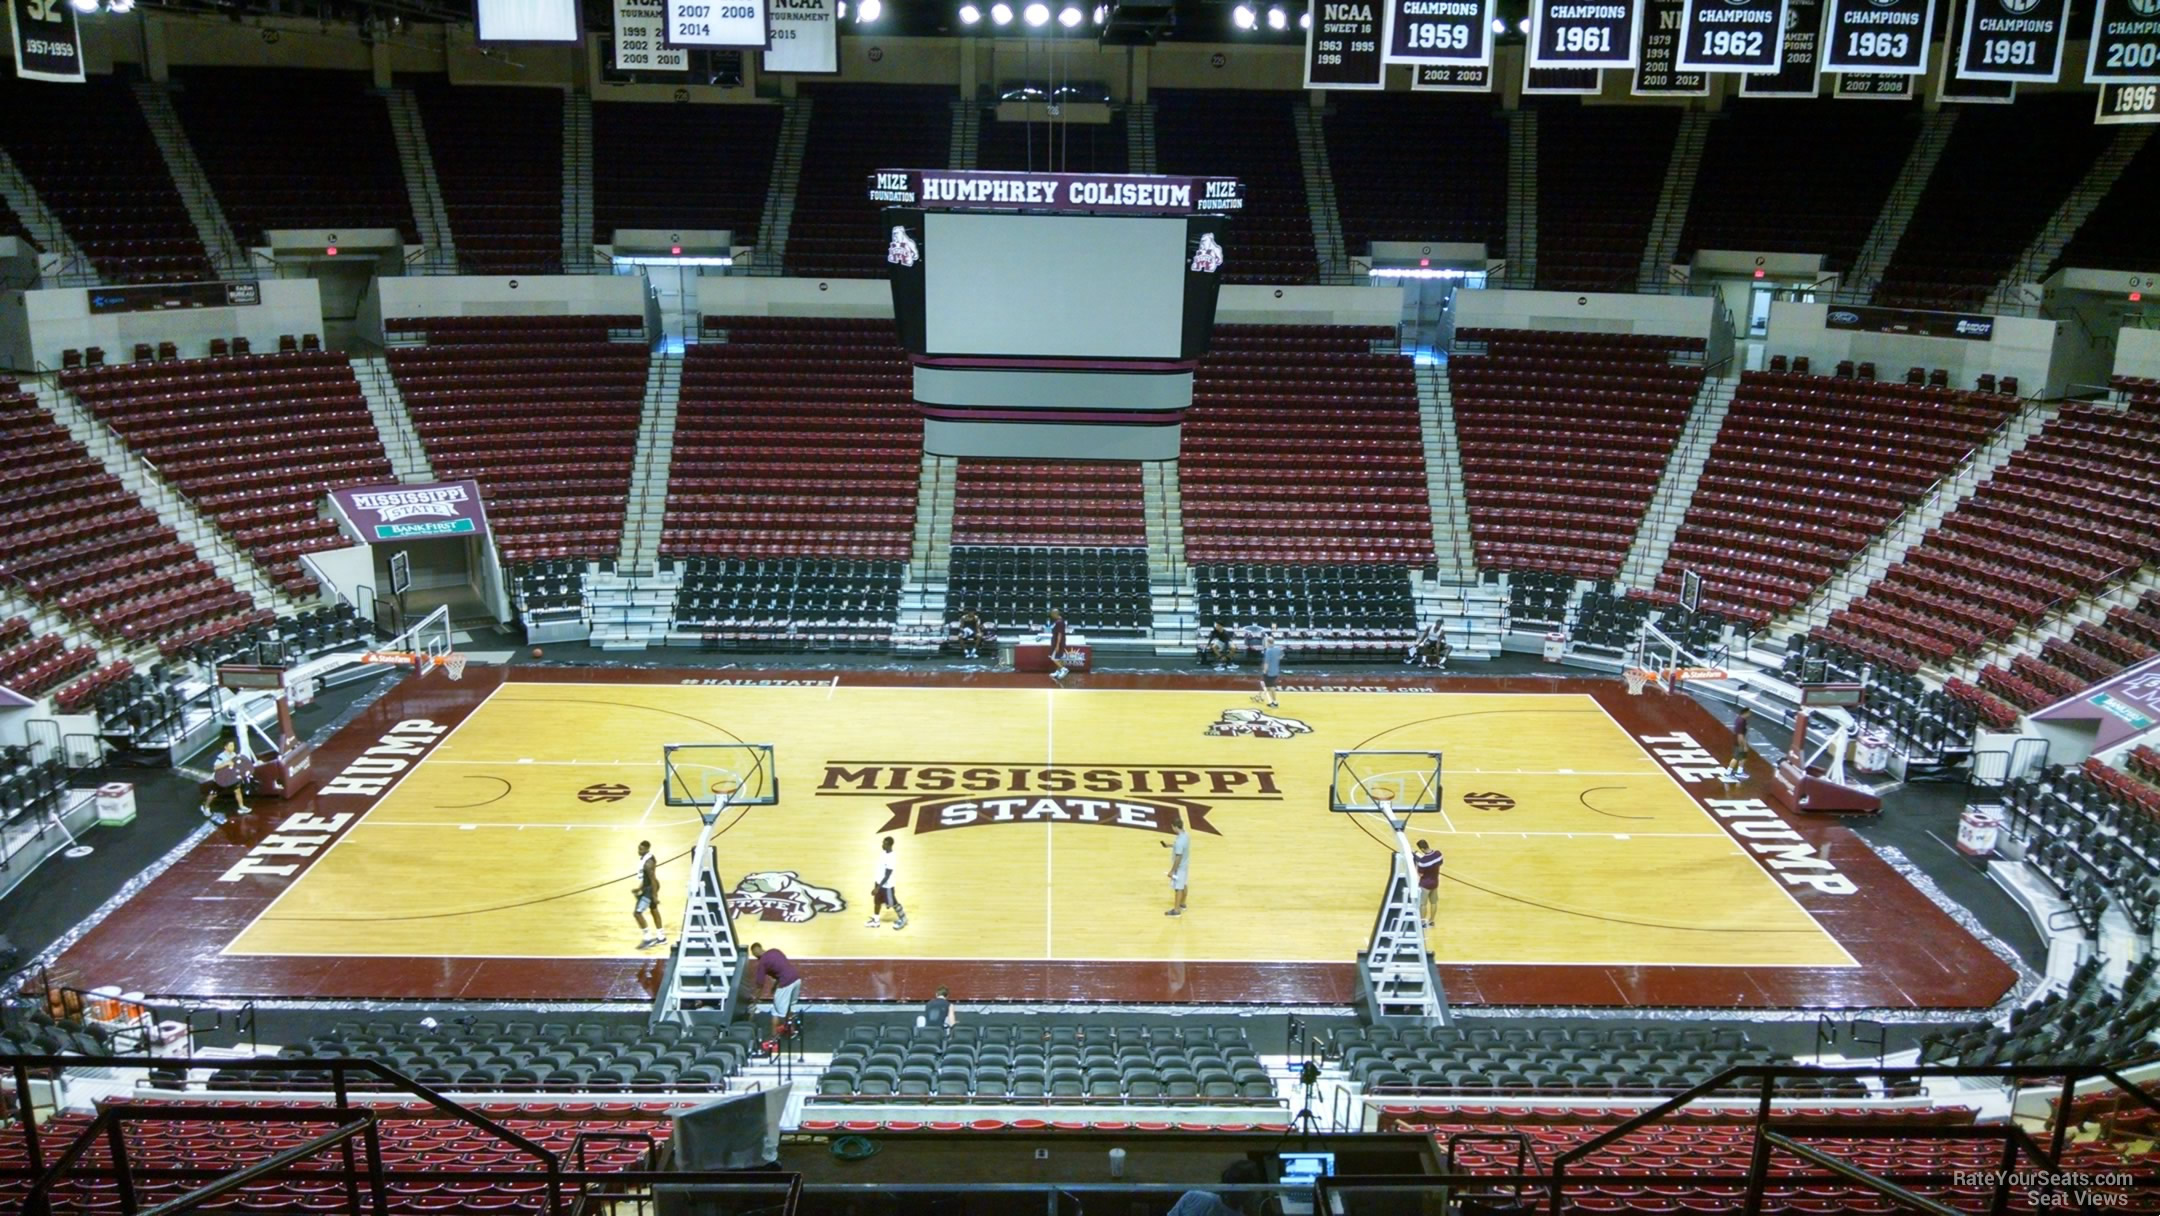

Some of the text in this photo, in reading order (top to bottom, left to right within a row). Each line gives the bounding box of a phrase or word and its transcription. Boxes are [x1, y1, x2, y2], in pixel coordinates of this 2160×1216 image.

[678, 6, 754, 19] 2007 2008
[1324, 4, 1373, 21] NCAA
[1403, 2, 1478, 16] CHAMPIONS
[1550, 6, 1625, 19] CHAMPIONS
[769, 12, 829, 21] TOURNAMENT
[1699, 10, 1773, 23] CHAMPIONS
[1844, 11, 1919, 25] CHAMPIONS
[623, 27, 647, 37] 1999
[679, 23, 710, 36] 2014
[1324, 23, 1372, 34] SWEET 16
[1980, 18, 2054, 33] CHAMPIONS
[770, 29, 797, 39] 2015
[1408, 22, 1469, 50] 1959
[1555, 27, 1611, 52] 1961
[1649, 35, 1671, 45] 1979
[27, 39, 75, 57] 1957-1959
[623, 41, 648, 50] 2002
[1318, 41, 1375, 52] 1963 1995
[1702, 31, 1763, 56] 1962
[1848, 32, 1909, 58] 1963
[1646, 49, 1670, 59] 1994
[1787, 53, 1812, 63] 2002
[1982, 40, 2037, 65] 1991
[624, 54, 680, 65] 2009 2010
[1317, 54, 1342, 65] 1996
[1645, 62, 1669, 72] 2001
[1424, 70, 1483, 81] 2002 2003
[1644, 76, 1700, 86] 2010 2012
[1846, 81, 1871, 91] 2007
[2114, 86, 2157, 112] 1996
[877, 173, 907, 190] MIZE
[922, 178, 1190, 206] HUMPHREY COLISEUM
[1205, 181, 1236, 198] MIZE
[870, 191, 915, 203] FOUNDATION
[1198, 198, 1243, 210] FOUNDATION
[352, 488, 467, 508] MISSISSIPPI
[391, 504, 441, 518] STATE
[680, 679, 831, 687] #HAILSTATE
[817, 766, 1283, 794] MISSISSIPPI
[216, 719, 448, 882] THE HUMP
[940, 798, 1158, 829] STATE
[1640, 731, 1858, 895] THE HUMP
